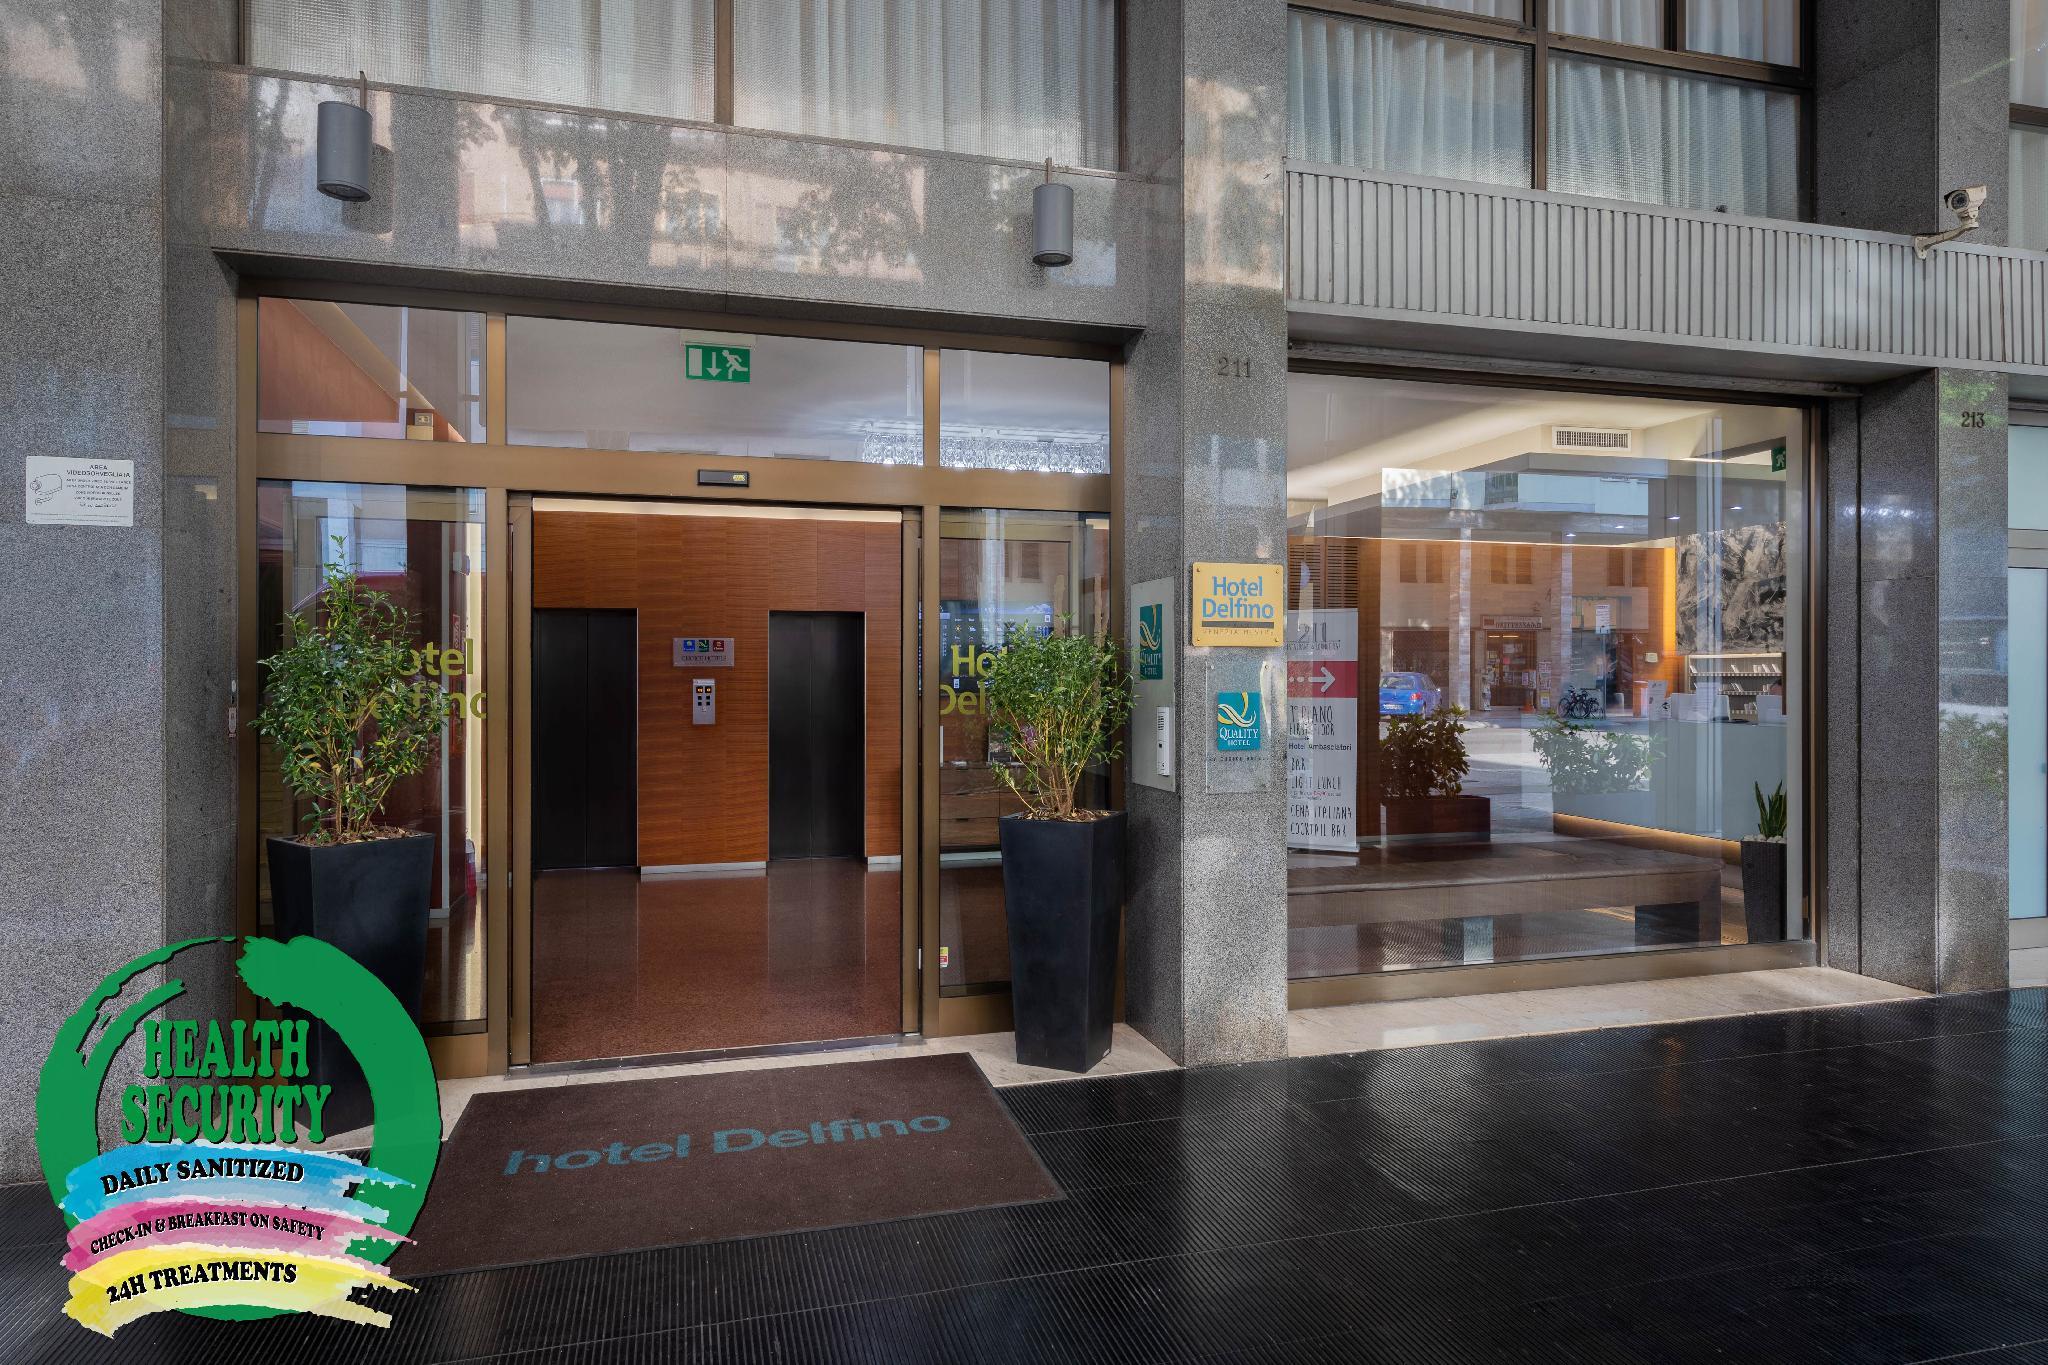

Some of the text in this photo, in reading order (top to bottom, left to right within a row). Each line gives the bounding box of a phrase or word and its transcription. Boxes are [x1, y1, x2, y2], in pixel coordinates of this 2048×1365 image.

[1217, 357, 1251, 378] 211
[1961, 411, 1985, 428] 213
[1212, 575, 1263, 597] Hotel
[1202, 597, 1275, 619] Delfino
[1219, 727, 1259, 741] QUALITY
[1290, 804, 1310, 818] CENA
[503, 1115, 951, 1176] hotel Delfino
